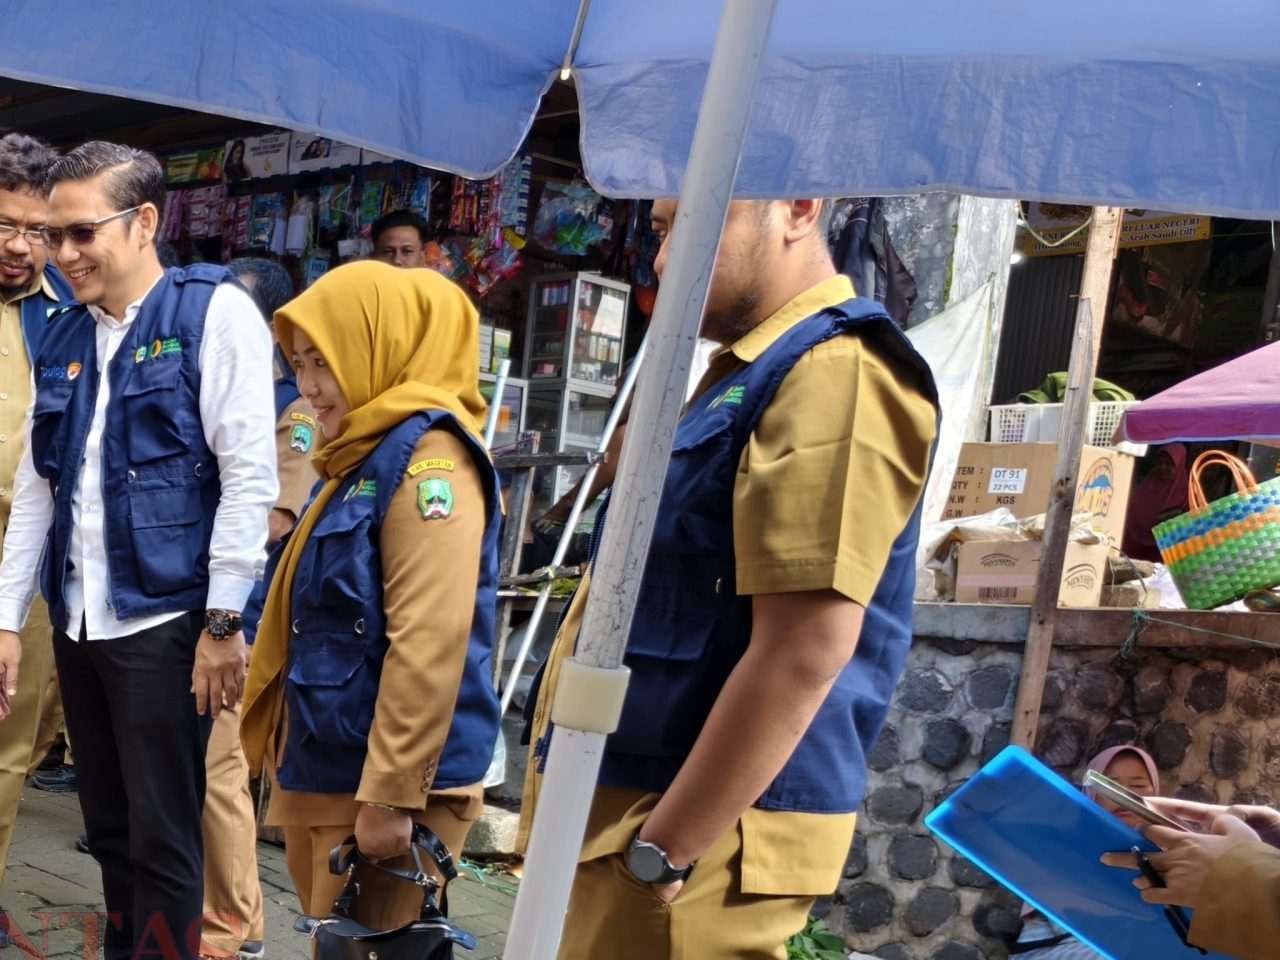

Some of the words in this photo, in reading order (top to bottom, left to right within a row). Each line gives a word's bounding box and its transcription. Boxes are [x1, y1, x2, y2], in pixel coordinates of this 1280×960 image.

[1134, 223, 1161, 232] LUAR
[1162, 217, 1200, 230] NEGERI
[1129, 233, 1150, 241] Arab
[1151, 230, 1177, 239] Saudi
[956, 466, 975, 476] TEM
[994, 470, 1007, 479] DT
[1009, 470, 1020, 479] 91
[951, 481, 969, 490] QTY
[996, 495, 1016, 505] KGS
